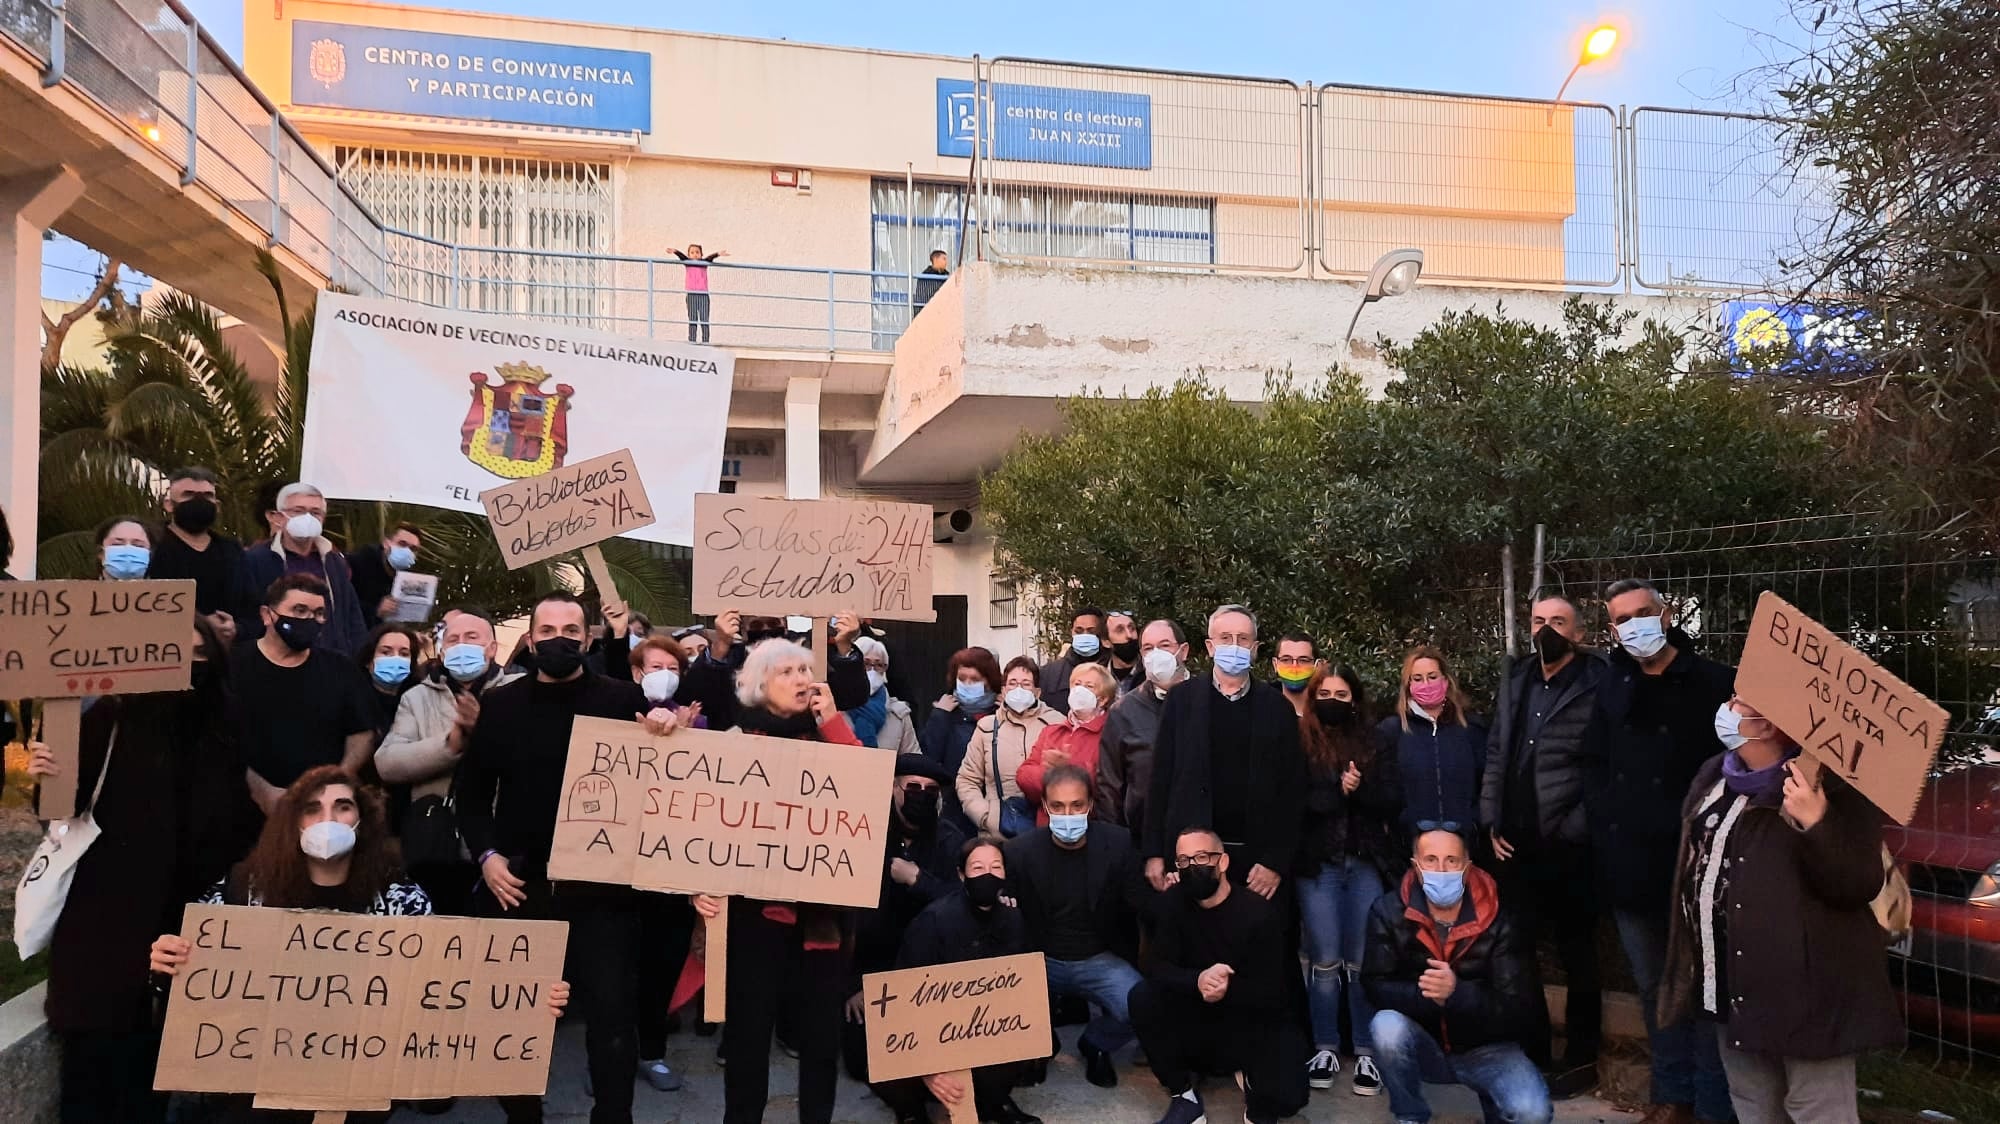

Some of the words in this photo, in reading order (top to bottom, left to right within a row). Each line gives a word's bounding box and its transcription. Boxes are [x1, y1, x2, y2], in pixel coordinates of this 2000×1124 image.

[364, 46, 450, 69] CENTRO
[458, 56, 484, 74] DE
[492, 58, 634, 86] CONVIVENCIA
[407, 77, 422, 93] Y
[428, 79, 594, 108] PARTICIPACIÓN
[1006, 105, 1058, 121] centro
[1064, 108, 1083, 123] de
[1088, 110, 1142, 128] lectura
[1029, 127, 1072, 144] JUAN
[1077, 131, 1121, 148] XXIII
[334, 309, 438, 336] ASOCIACIÓN
[442, 324, 465, 340] DE
[469, 328, 542, 349] VECINOS
[545, 337, 568, 353] DE
[573, 341, 718, 375] VILLAFRANQUEZA
[492, 461, 627, 526] Bibliotecas
[511, 507, 596, 555] abiertas
[705, 507, 822, 555] Salas
[856, 515, 929, 567] 24H
[90, 591, 186, 616] LUCES
[717, 555, 854, 599] estudio
[869, 569, 912, 611] YA
[47, 624, 67, 646] Y
[50, 643, 181, 667] CULTURA
[1806, 676, 1884, 746] ABIERTA
[1804, 704, 1864, 780] YA!
[578, 780, 610, 795] RIP
[591, 742, 770, 787] BARCALA
[800, 770, 838, 799] DA
[644, 788, 871, 840] SEPULTURA
[587, 828, 613, 853] A
[638, 832, 672, 860] LA
[685, 838, 853, 877] CULTURA
[196, 918, 241, 950] EL
[285, 923, 423, 958] ACCESO
[444, 935, 462, 960] A
[484, 934, 530, 962] LA
[185, 968, 388, 1008] CULTURA
[421, 980, 471, 1010] ES
[491, 983, 538, 1010] UN
[910, 968, 1022, 1007] inversión
[195, 1023, 386, 1061] DERECHO
[447, 1035, 476, 1061] 44
[493, 1034, 540, 1061] C.E.
[886, 1031, 918, 1053] en
[939, 1004, 1030, 1043] cultura
